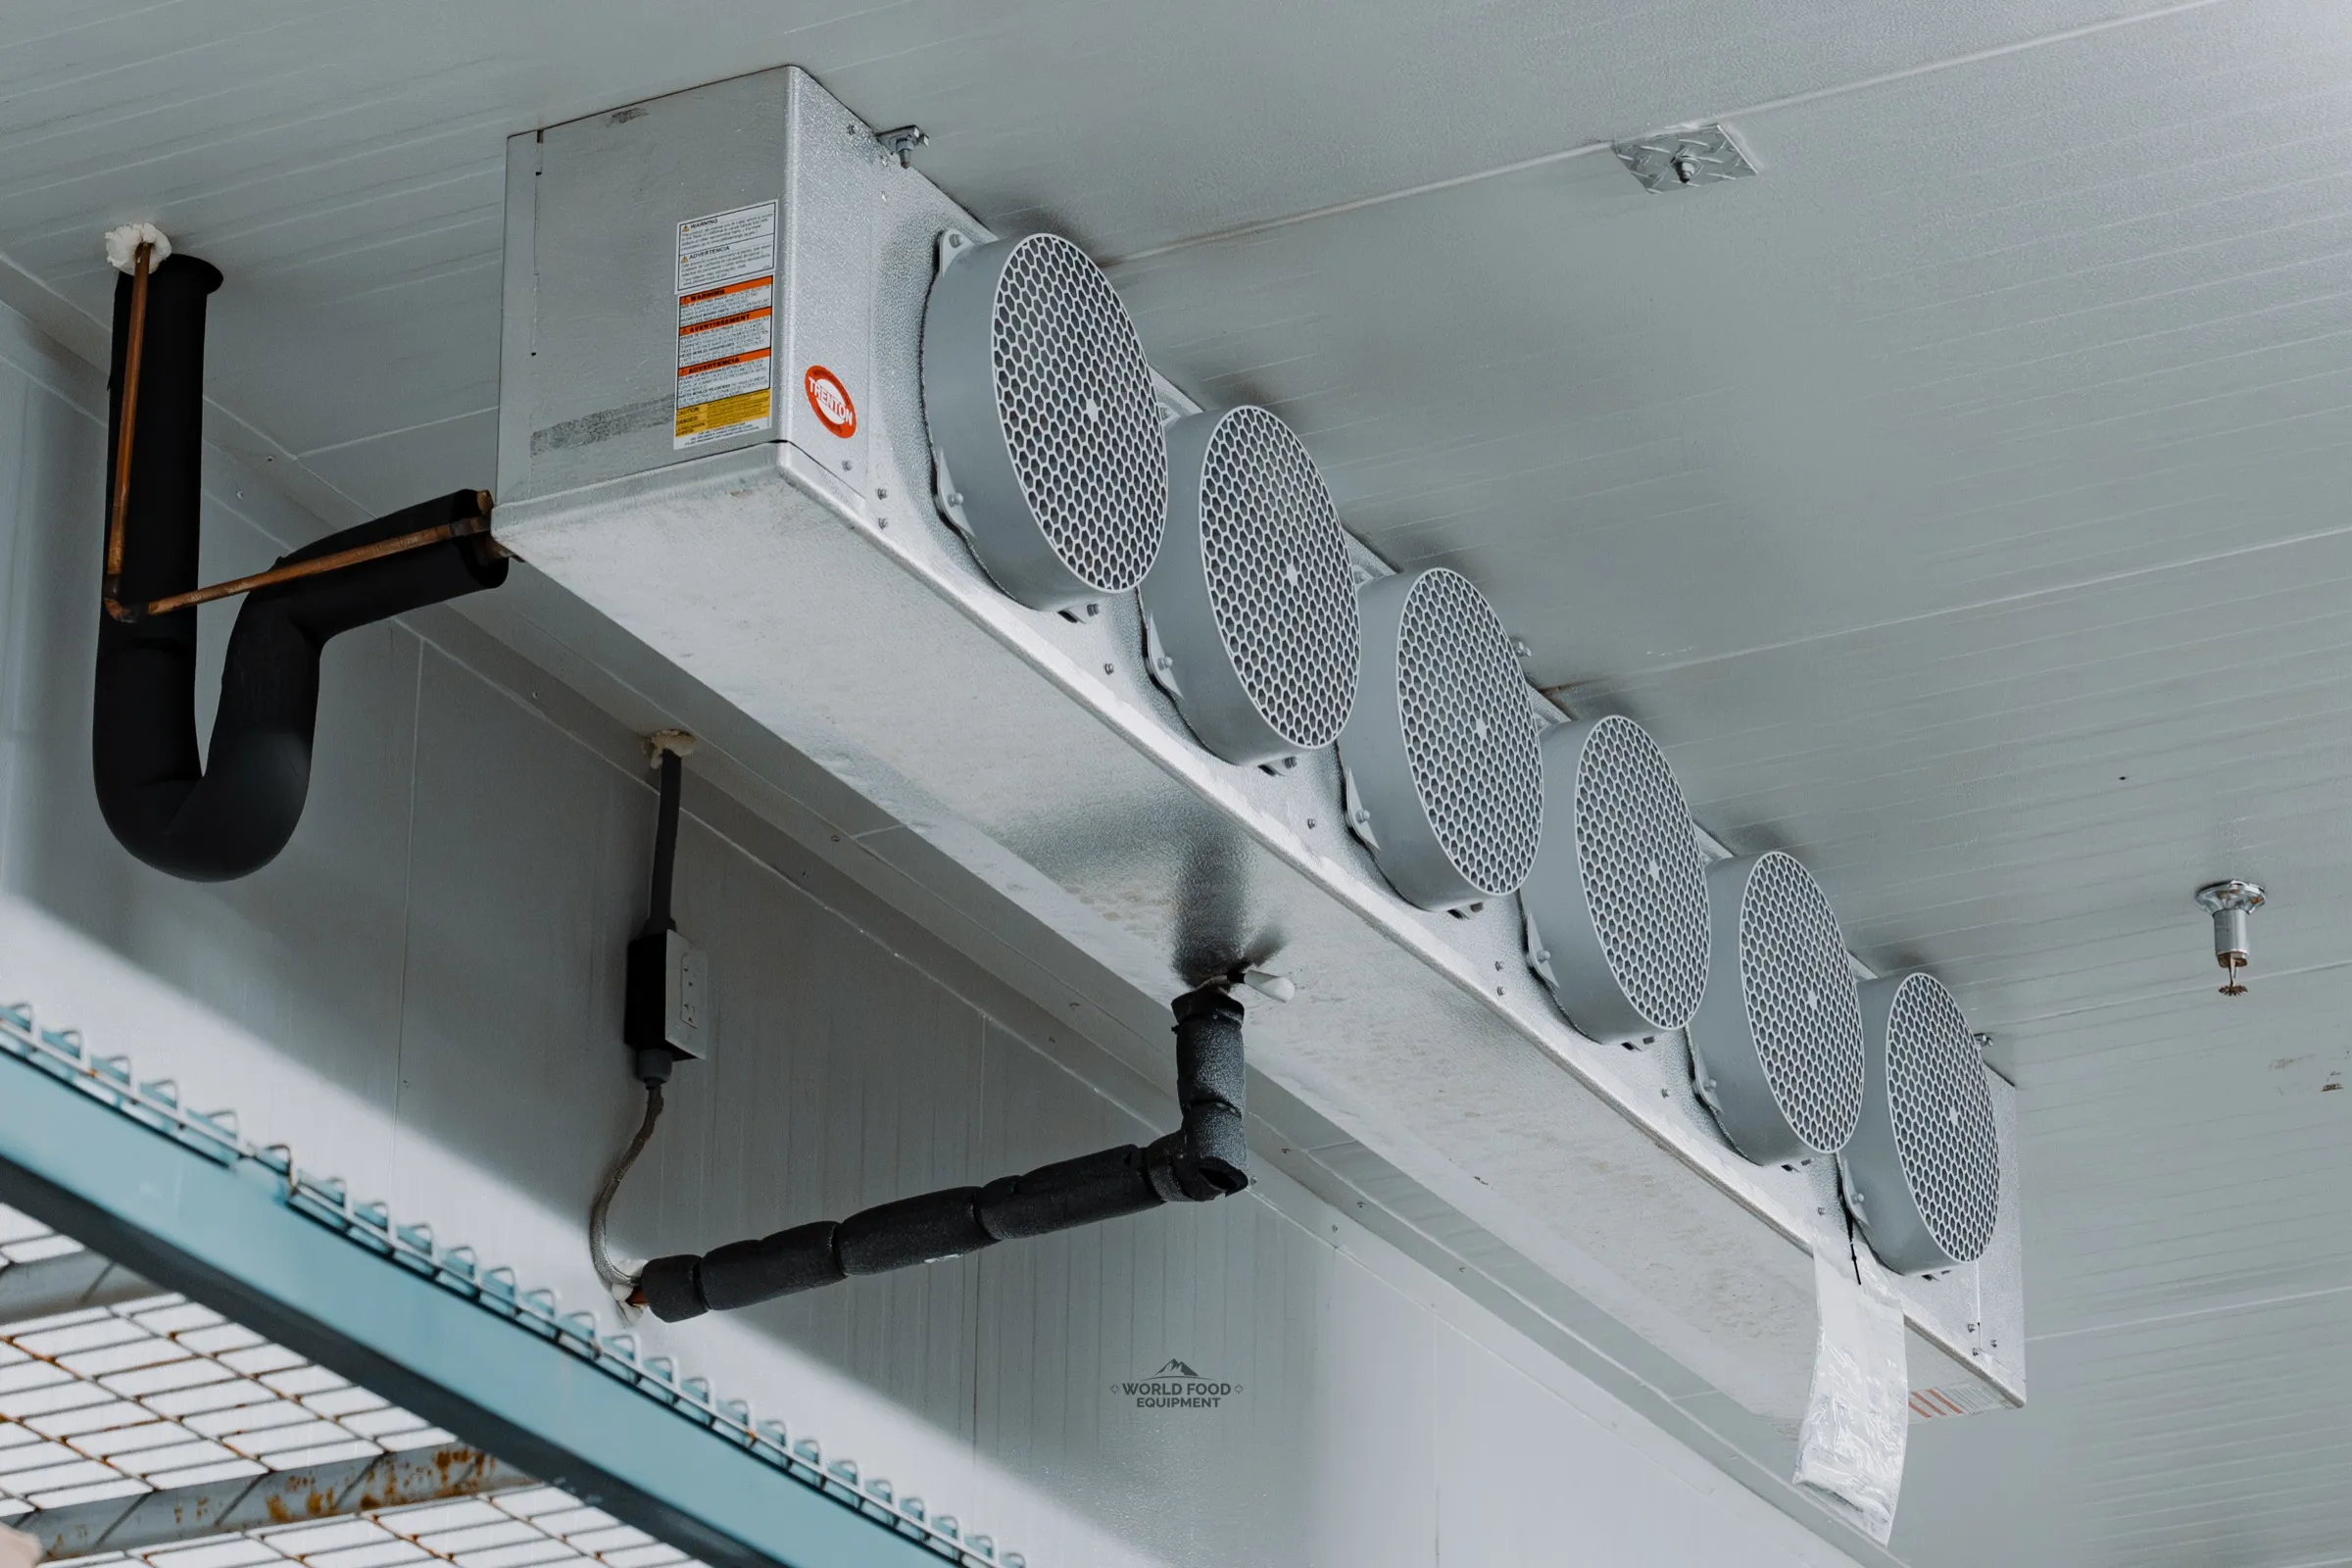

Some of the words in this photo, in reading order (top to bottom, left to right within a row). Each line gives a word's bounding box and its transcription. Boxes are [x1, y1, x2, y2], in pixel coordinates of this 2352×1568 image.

[690, 218, 718, 229] WARNING
[689, 246, 730, 260] ADVERTENCIA
[690, 289, 725, 301] WARNING
[689, 314, 751, 333] AVERTISSEMENT
[688, 358, 740, 374] ADVERTENCIA
[808, 376, 853, 426] TRENTON
